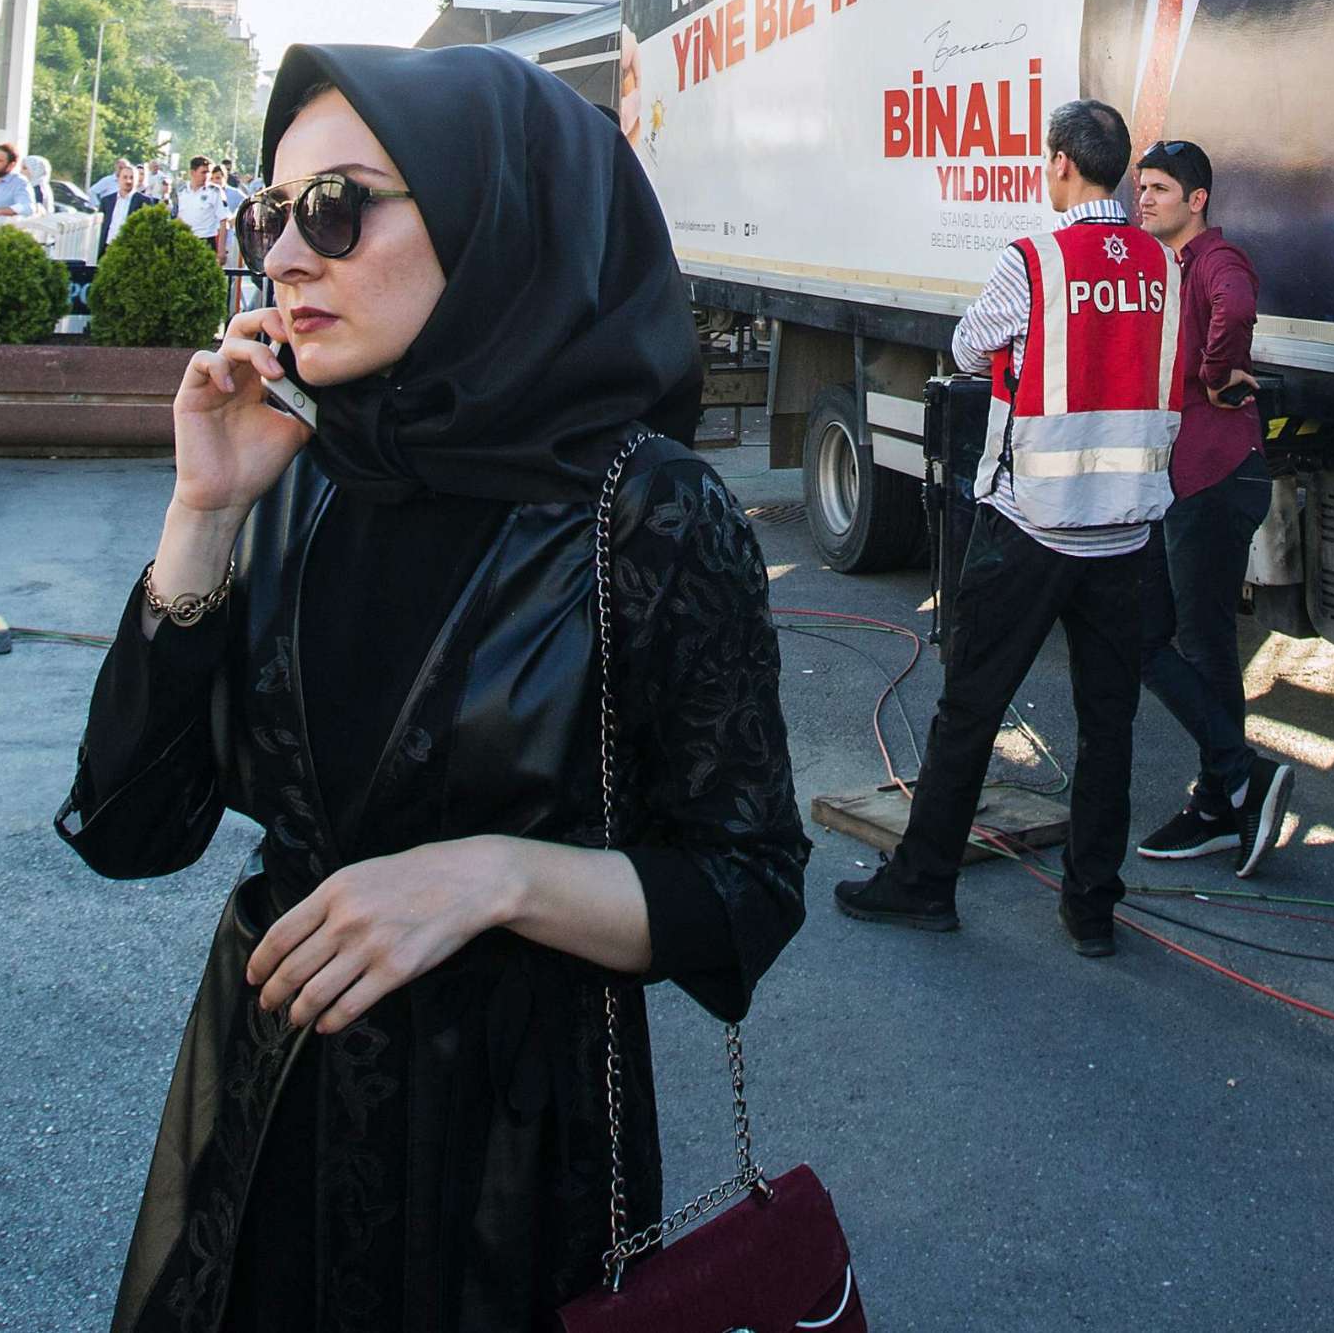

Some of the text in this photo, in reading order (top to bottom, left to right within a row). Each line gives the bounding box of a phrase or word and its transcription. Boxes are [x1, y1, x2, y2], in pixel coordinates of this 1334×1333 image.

[884, 58, 1042, 158] BİNALİ
[936, 165, 1042, 204] YILDIRIM
[1070, 271, 1164, 314] POLİS
